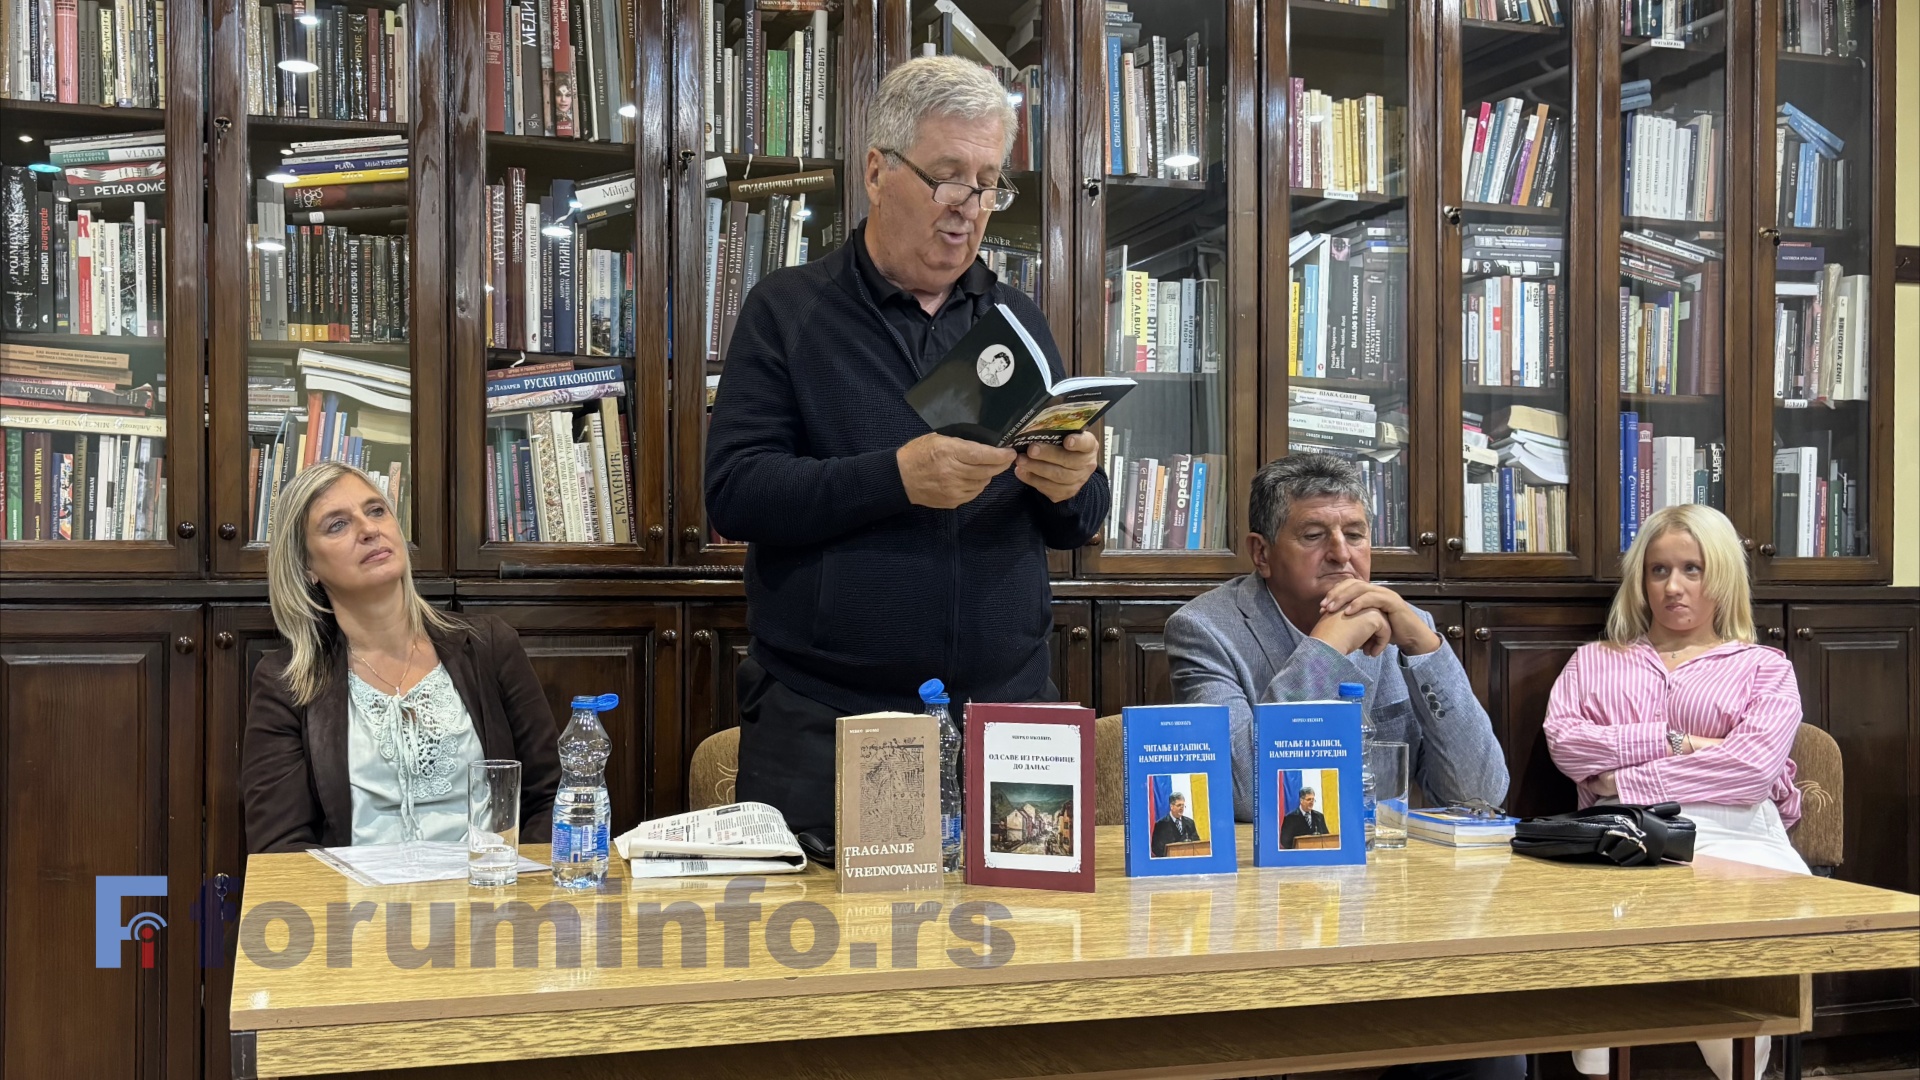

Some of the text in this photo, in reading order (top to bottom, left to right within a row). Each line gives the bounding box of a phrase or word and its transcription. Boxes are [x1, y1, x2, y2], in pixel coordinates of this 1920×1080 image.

[521, 0, 538, 48] МЕДИ
[551, 13, 561, 50] nemogućeg
[745, 9, 755, 47] ЦРТЕЖА
[745, 47, 754, 62] 180
[817, 47, 826, 101] ЛАИНОВИЋ
[745, 77, 754, 120] ЛУКИЈАН
[1112, 91, 1121, 117] КОНАЦ
[1113, 118, 1122, 148] СВИЛЕН
[94, 184, 135, 197] PETAR
[601, 184, 630, 198] Milija
[39, 207, 51, 251] avangarde
[350, 245, 358, 262] ЛИК
[558, 222, 572, 277] ХИЛАНДР
[728, 221, 738, 274] СТУДЕНИЧКА
[735, 236, 744, 274] РИЗНИЦА
[350, 269, 359, 295] ОБЛИК
[1352, 275, 1360, 314] TRADICIJOM
[1133, 275, 1143, 340] 1001 ALBUM
[1532, 287, 1540, 308] rasa
[350, 295, 360, 334] ПРИРОДНИ
[1351, 320, 1359, 349] DIJALOG
[1835, 316, 1845, 384] BIBLIOTEKA ZENIT
[523, 376, 557, 390] РУСКИ
[559, 369, 616, 386] ИКОНОПИС
[33, 447, 43, 504] ЛИКОВНА КРИТИКА
[1176, 454, 1192, 509] operu
[1136, 493, 1146, 524] OPERA
[1138, 753, 1173, 764] НАМЕРНИ
[1179, 752, 1217, 763] УЗГРЕДНИ
[1143, 743, 1172, 753] ЧИТАЊЕ
[1179, 742, 1211, 752] ЗАПИСИ,
[1269, 749, 1304, 759] НАМЕРНИ
[1311, 748, 1348, 759] УЗГРЕДНИ
[1274, 739, 1304, 749] ЧИТАЊЕ
[1310, 738, 1343, 748] ЗАПИСИ,
[988, 753, 1076, 764] ОД САВЕ ИЗ ГРАБОВИЦЕ
[1012, 763, 1051, 772] ДО ДАНАС
[843, 842, 915, 858] TRAGANJE
[844, 857, 850, 868] I
[845, 862, 938, 879] VREDNOVANJE
